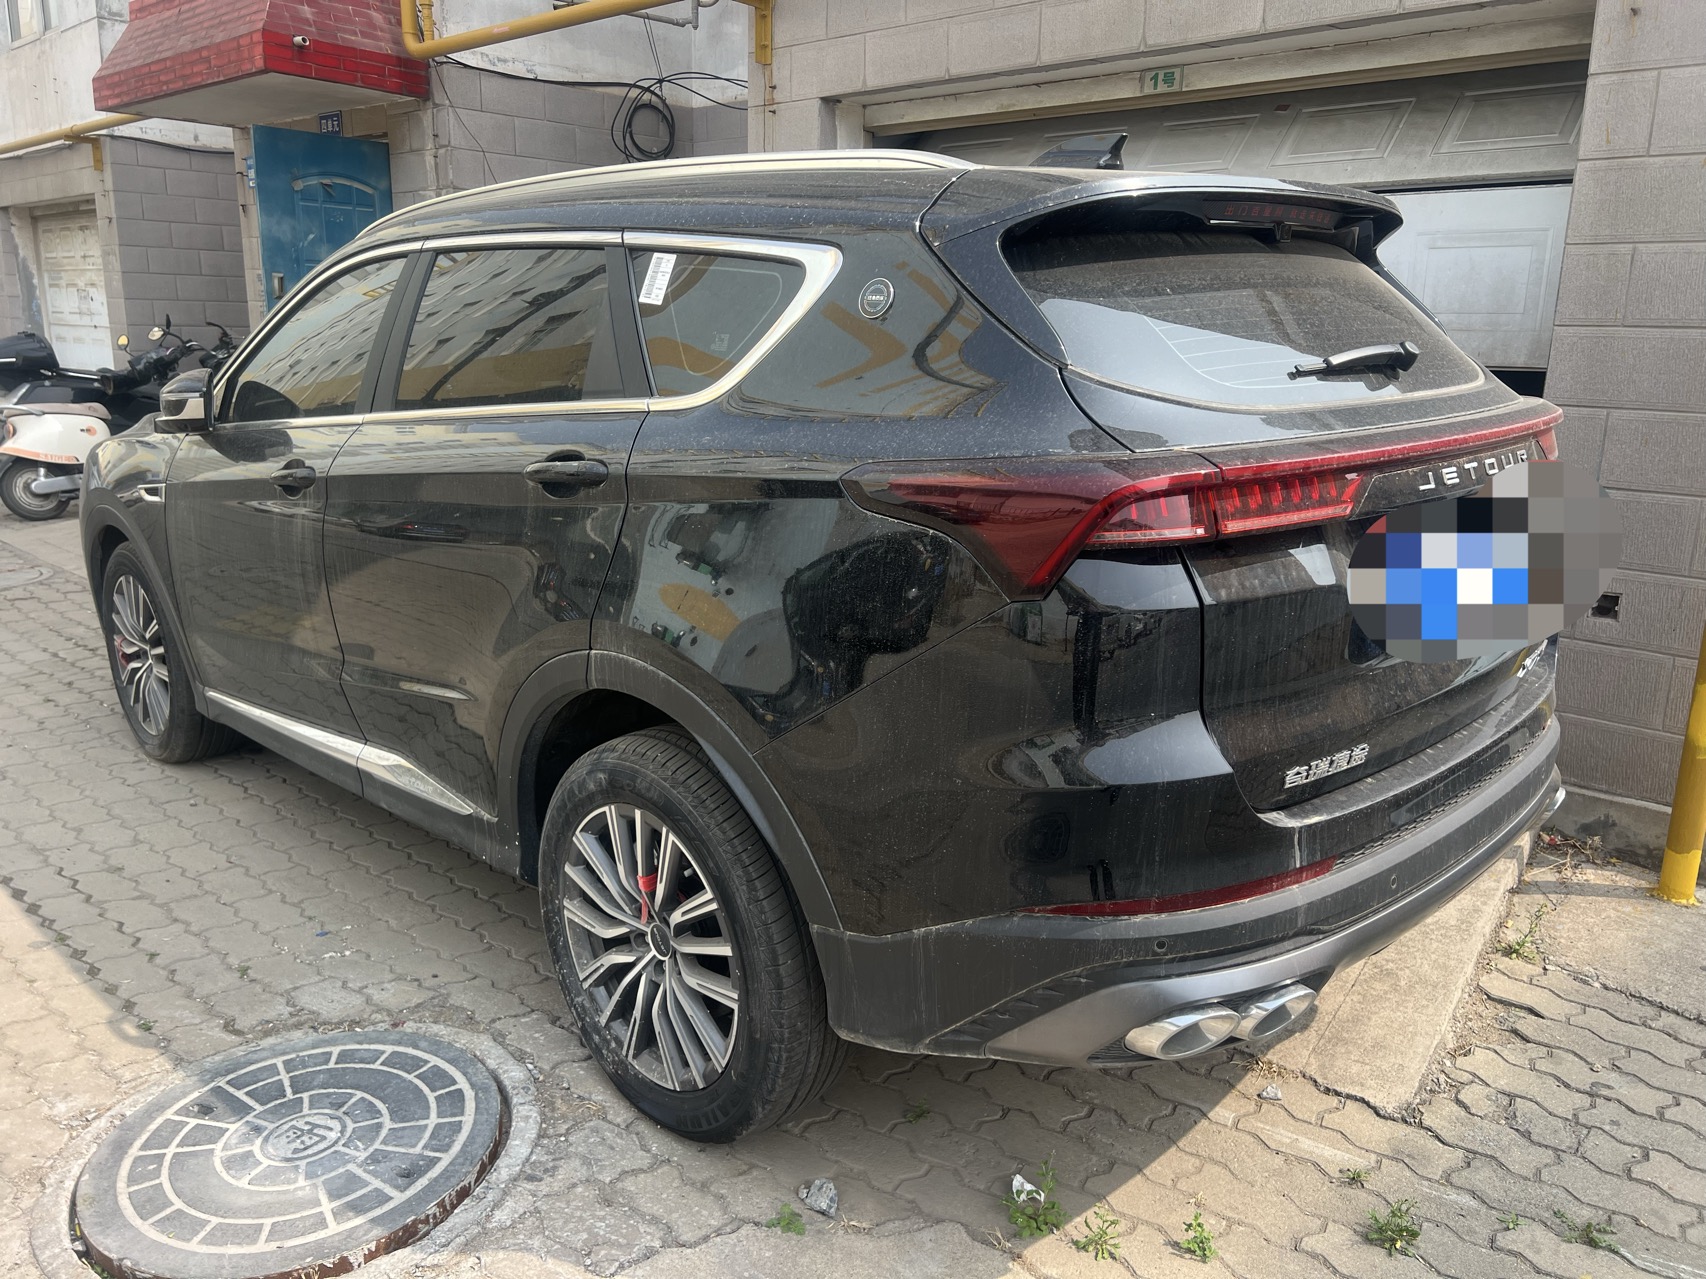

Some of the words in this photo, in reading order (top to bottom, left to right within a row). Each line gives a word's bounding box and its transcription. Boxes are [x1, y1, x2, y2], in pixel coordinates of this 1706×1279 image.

[1149, 71, 1176, 90] 1号
[321, 117, 339, 132] 四单元
[1418, 449, 1527, 491] JETOUR
